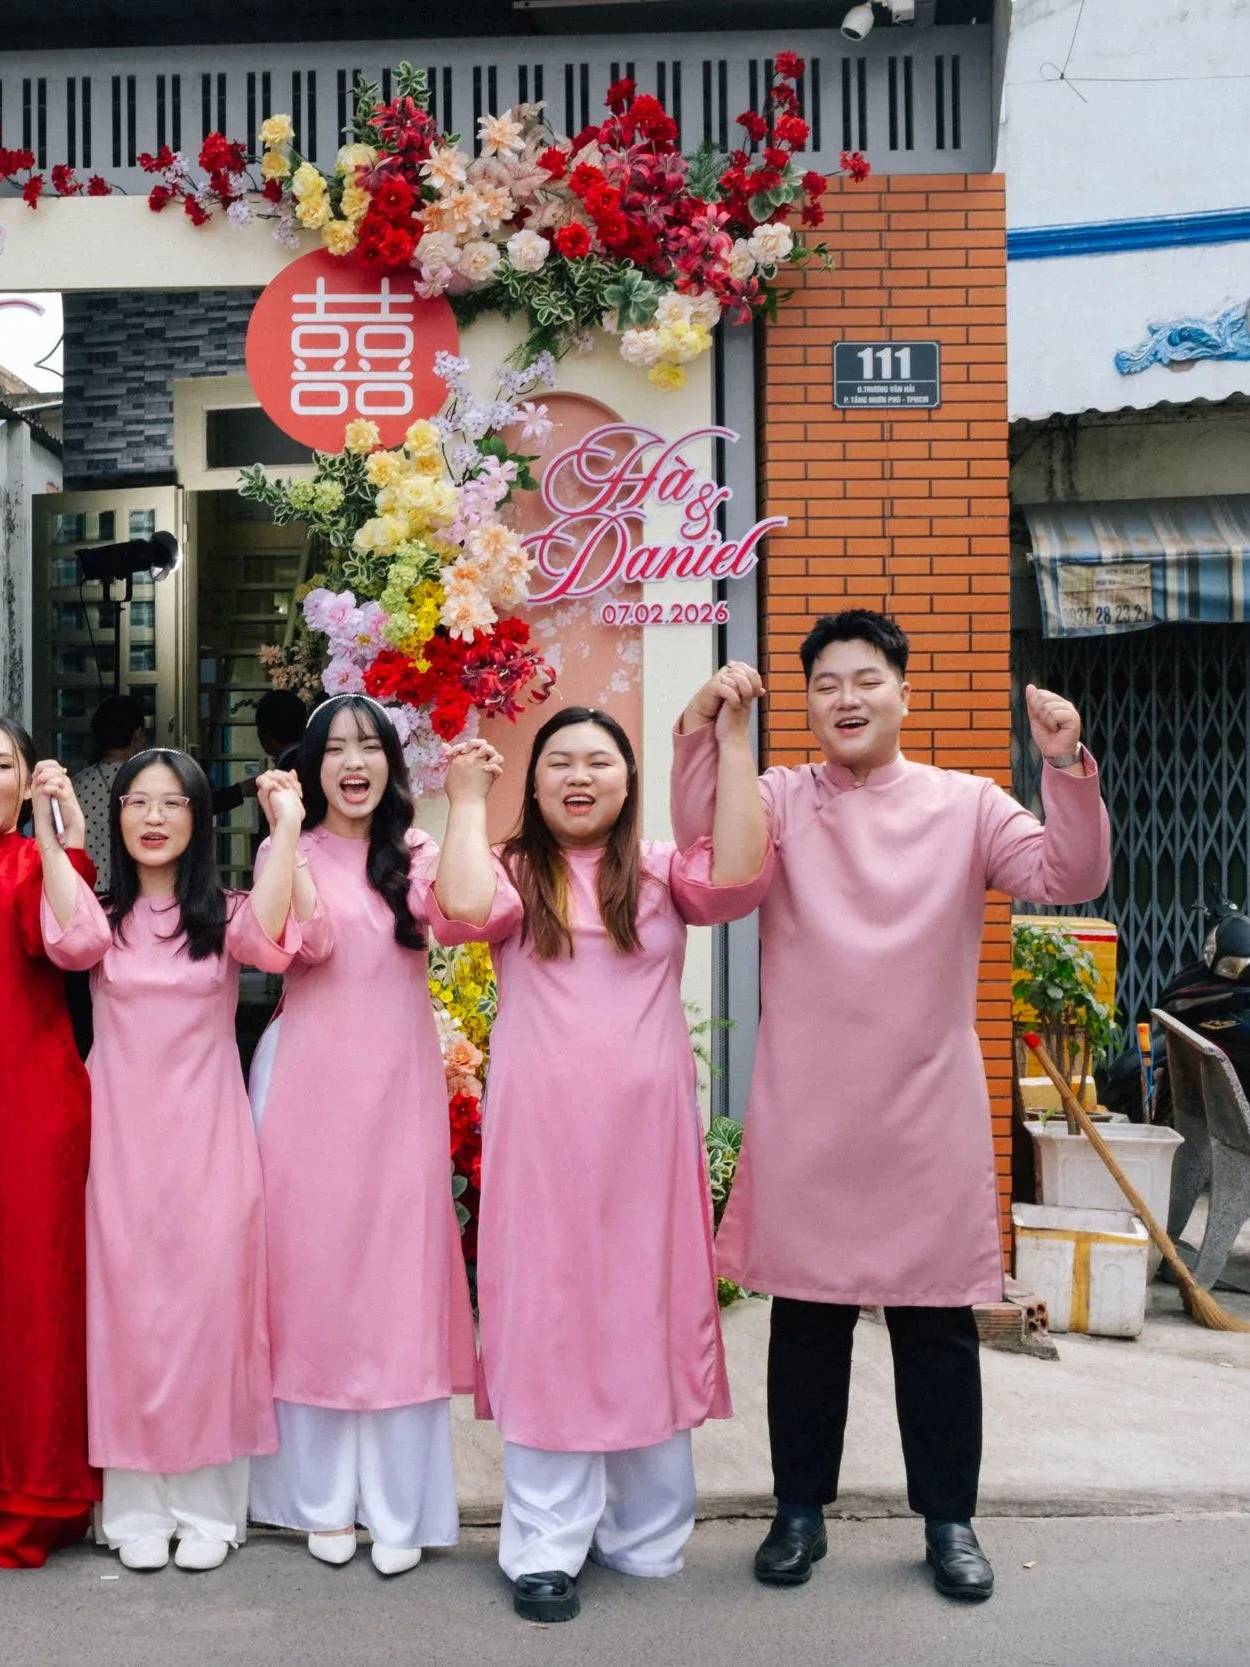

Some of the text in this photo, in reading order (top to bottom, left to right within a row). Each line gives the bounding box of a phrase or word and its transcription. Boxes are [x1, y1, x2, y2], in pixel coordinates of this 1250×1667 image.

[291, 277, 414, 415] 囍
[857, 347, 911, 379] 111
[543, 424, 737, 515] Hà
[681, 483, 729, 541] &
[520, 509, 786, 603] Daniel
[602, 604, 729, 624] 07.02.2026
[1096, 605, 1111, 624] 28
